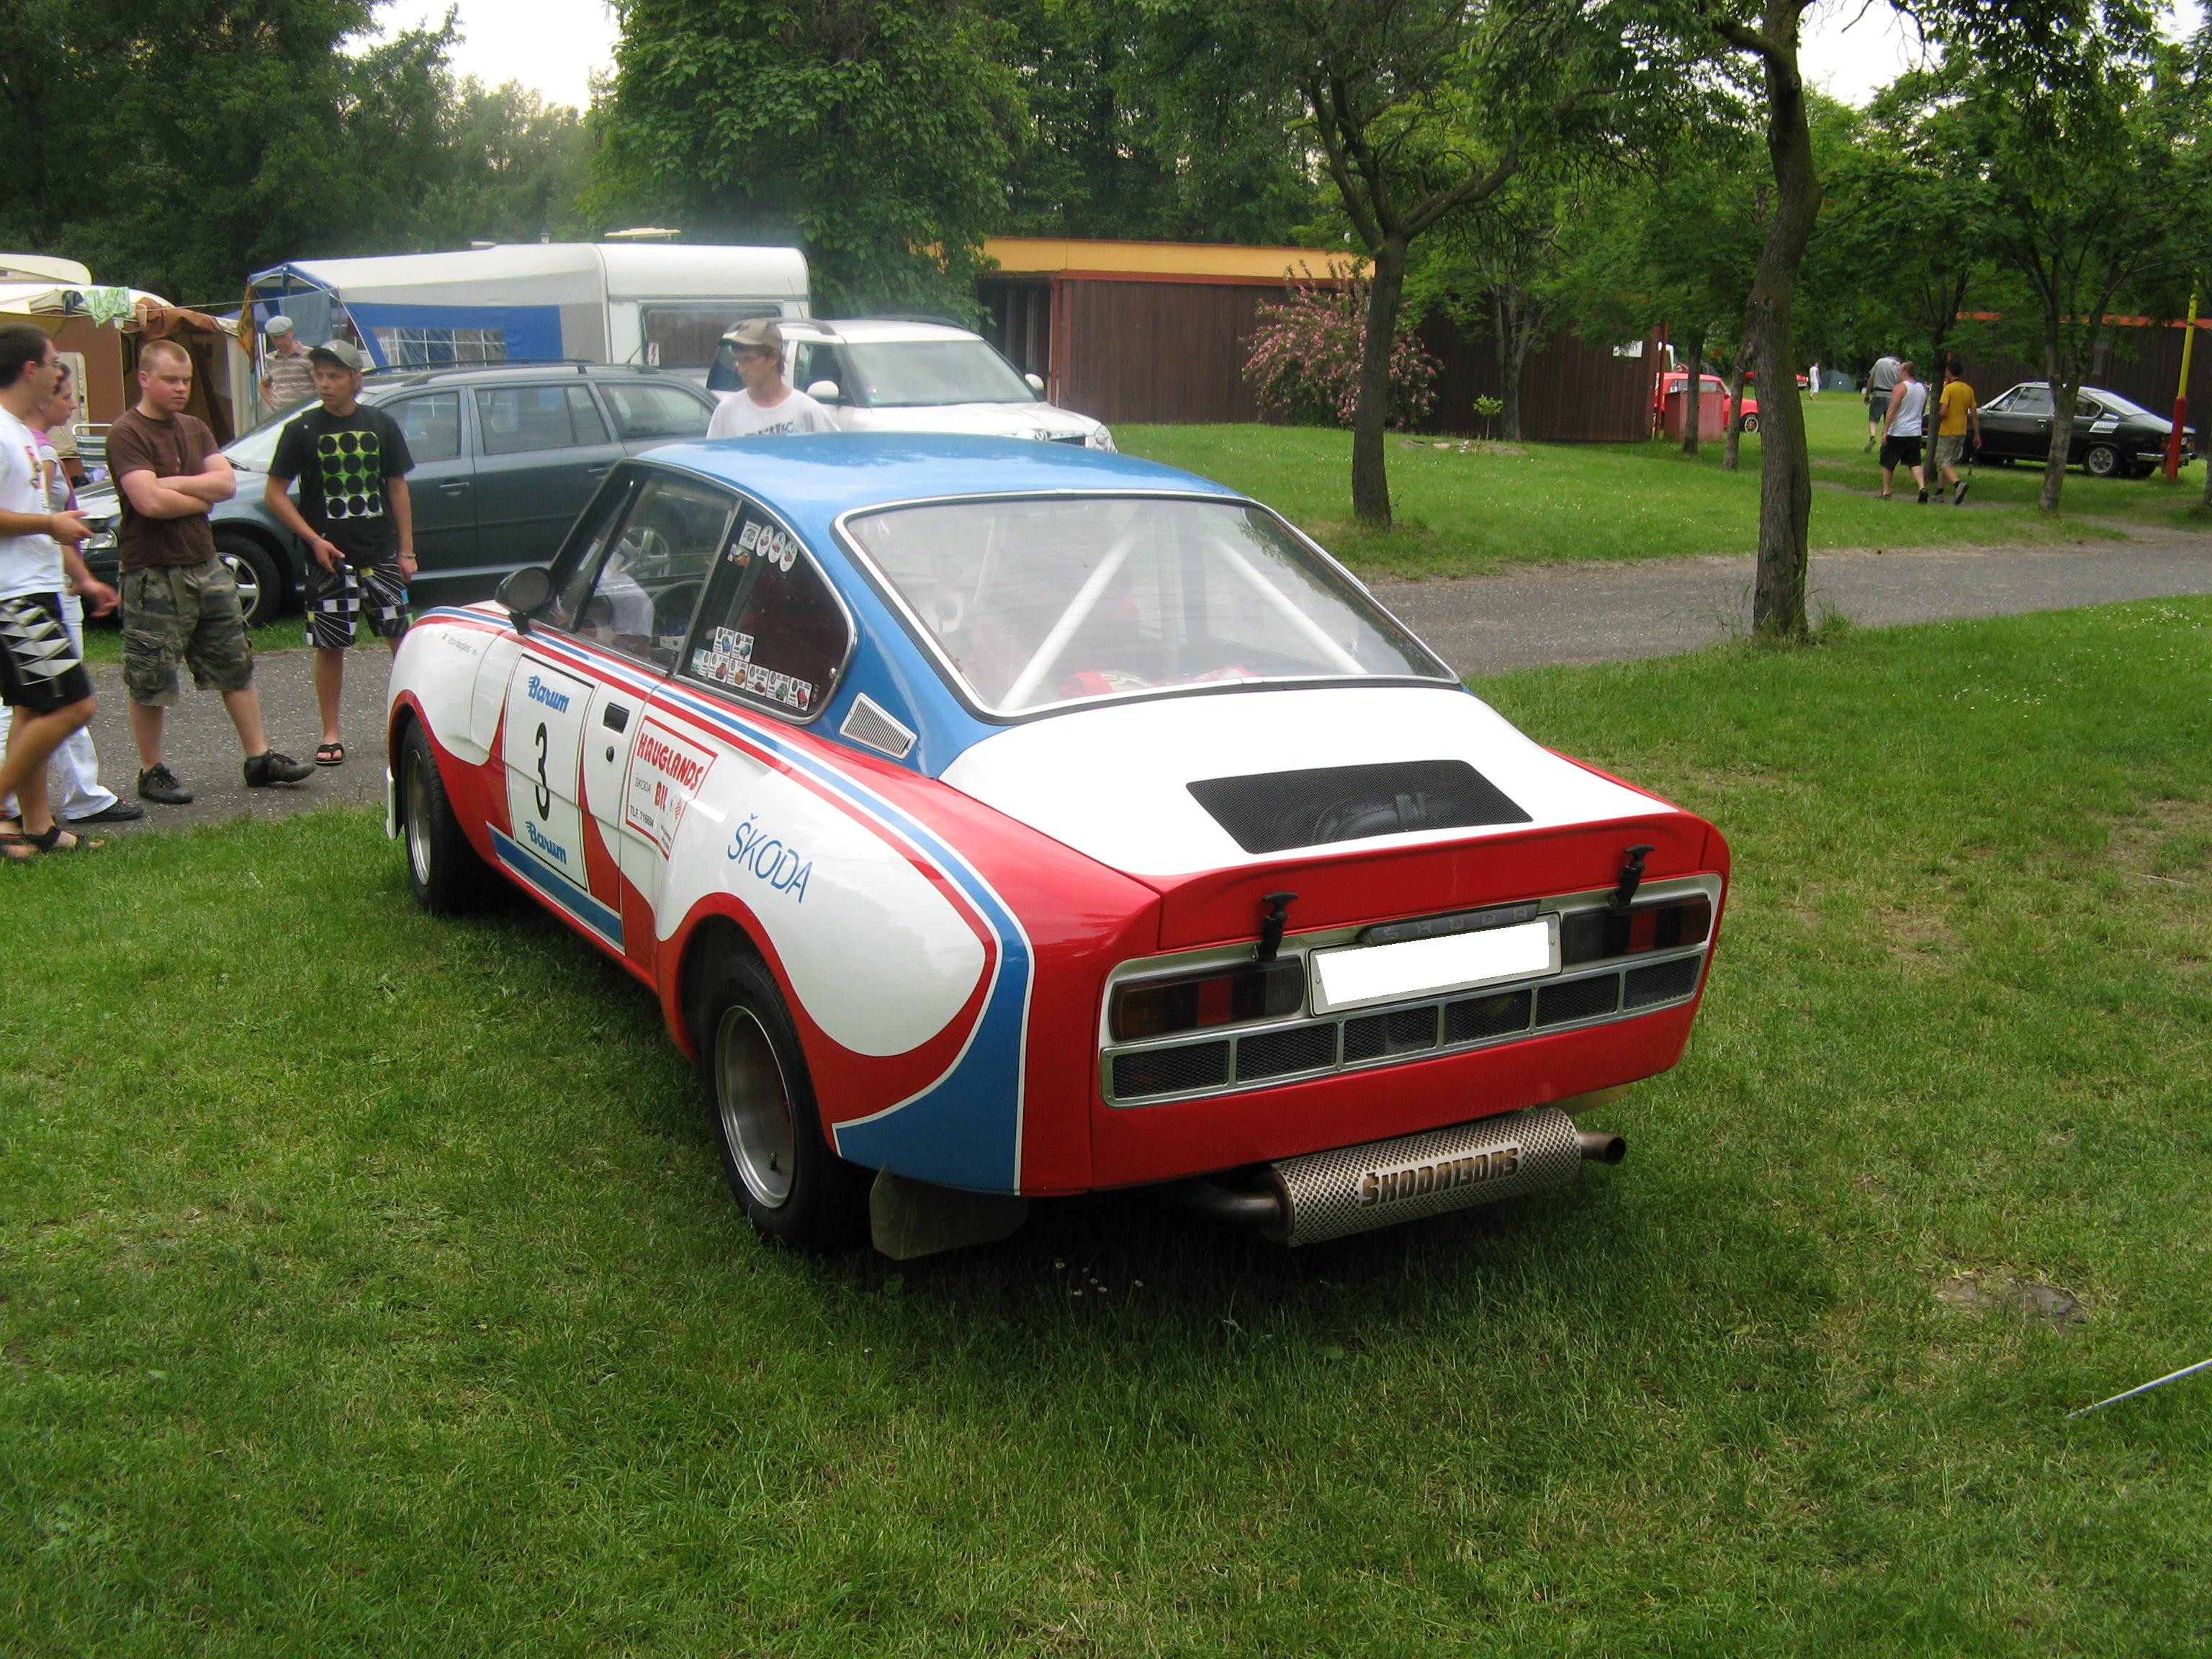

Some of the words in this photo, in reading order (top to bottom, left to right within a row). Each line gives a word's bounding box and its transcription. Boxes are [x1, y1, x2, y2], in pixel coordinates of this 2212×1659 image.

[529, 675, 570, 714] Barum
[535, 722, 549, 821] 3
[637, 733, 704, 791] HAUGLANDS
[655, 781, 668, 812] BIL
[526, 821, 567, 864] Barum
[727, 813, 813, 903] ŠKODA
